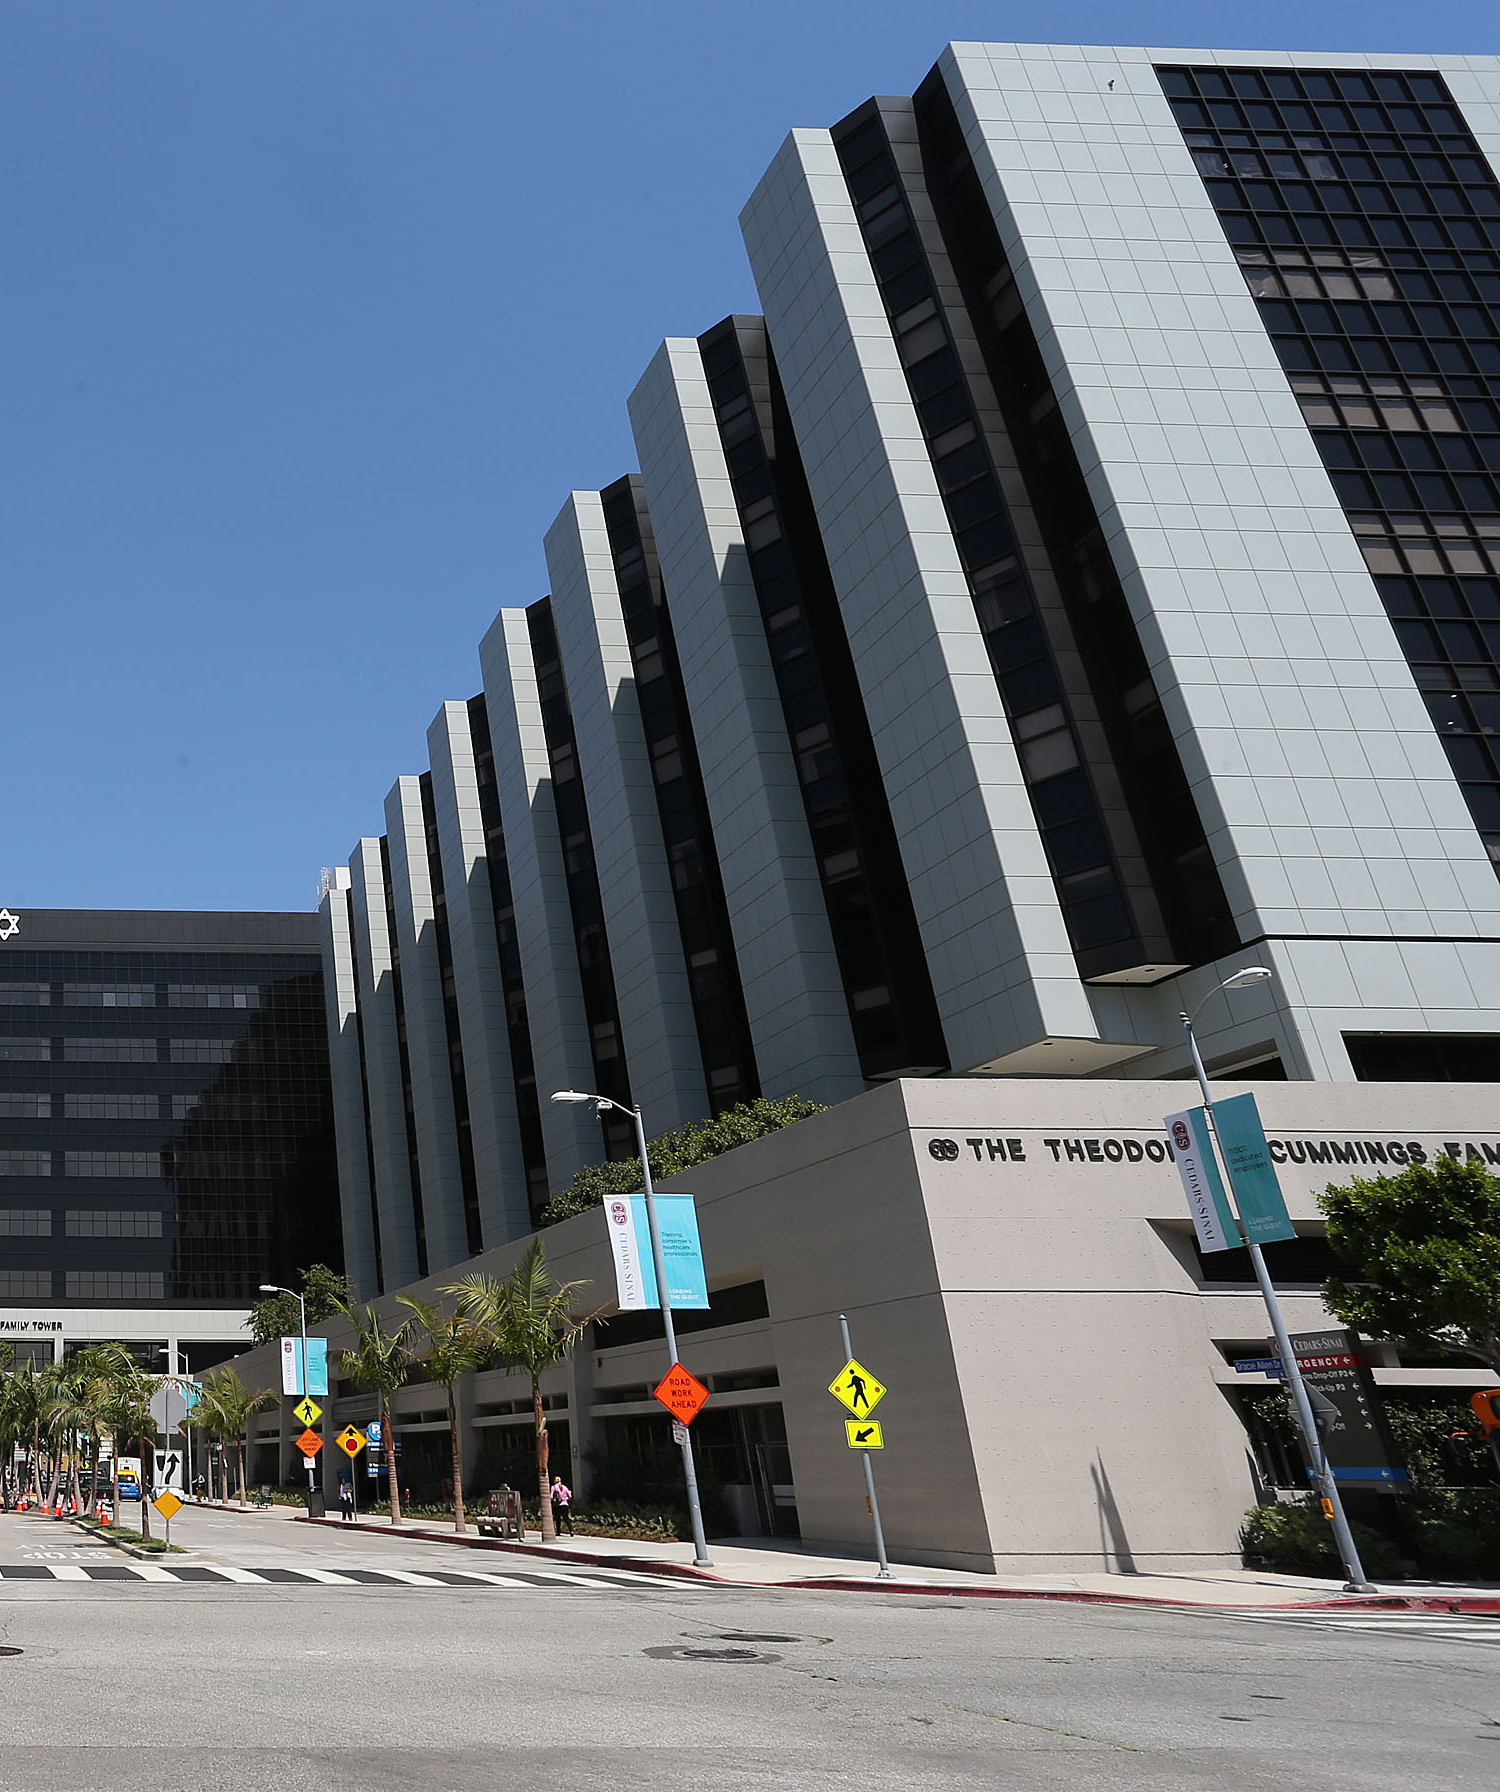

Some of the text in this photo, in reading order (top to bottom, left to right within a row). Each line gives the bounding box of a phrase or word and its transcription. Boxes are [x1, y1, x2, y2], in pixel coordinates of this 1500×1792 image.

[966, 1138, 1027, 1162] THE
[1268, 1139, 1428, 1166] CUMMINGS
[1231, 1152, 1263, 1165] dedicated
[1184, 1158, 1215, 1240] CEDARS-SINAI
[0, 1321, 29, 1331] FAMILY
[32, 1321, 63, 1332] TOWER
[1293, 1337, 1344, 1351] CEDARS-SINAI
[1297, 1357, 1339, 1368] RGENCY
[669, 1378, 690, 1386] ROAD
[671, 1389, 693, 1398] WORK
[671, 1400, 697, 1409] AHEAD
[22, 1551, 113, 1560] STOP
